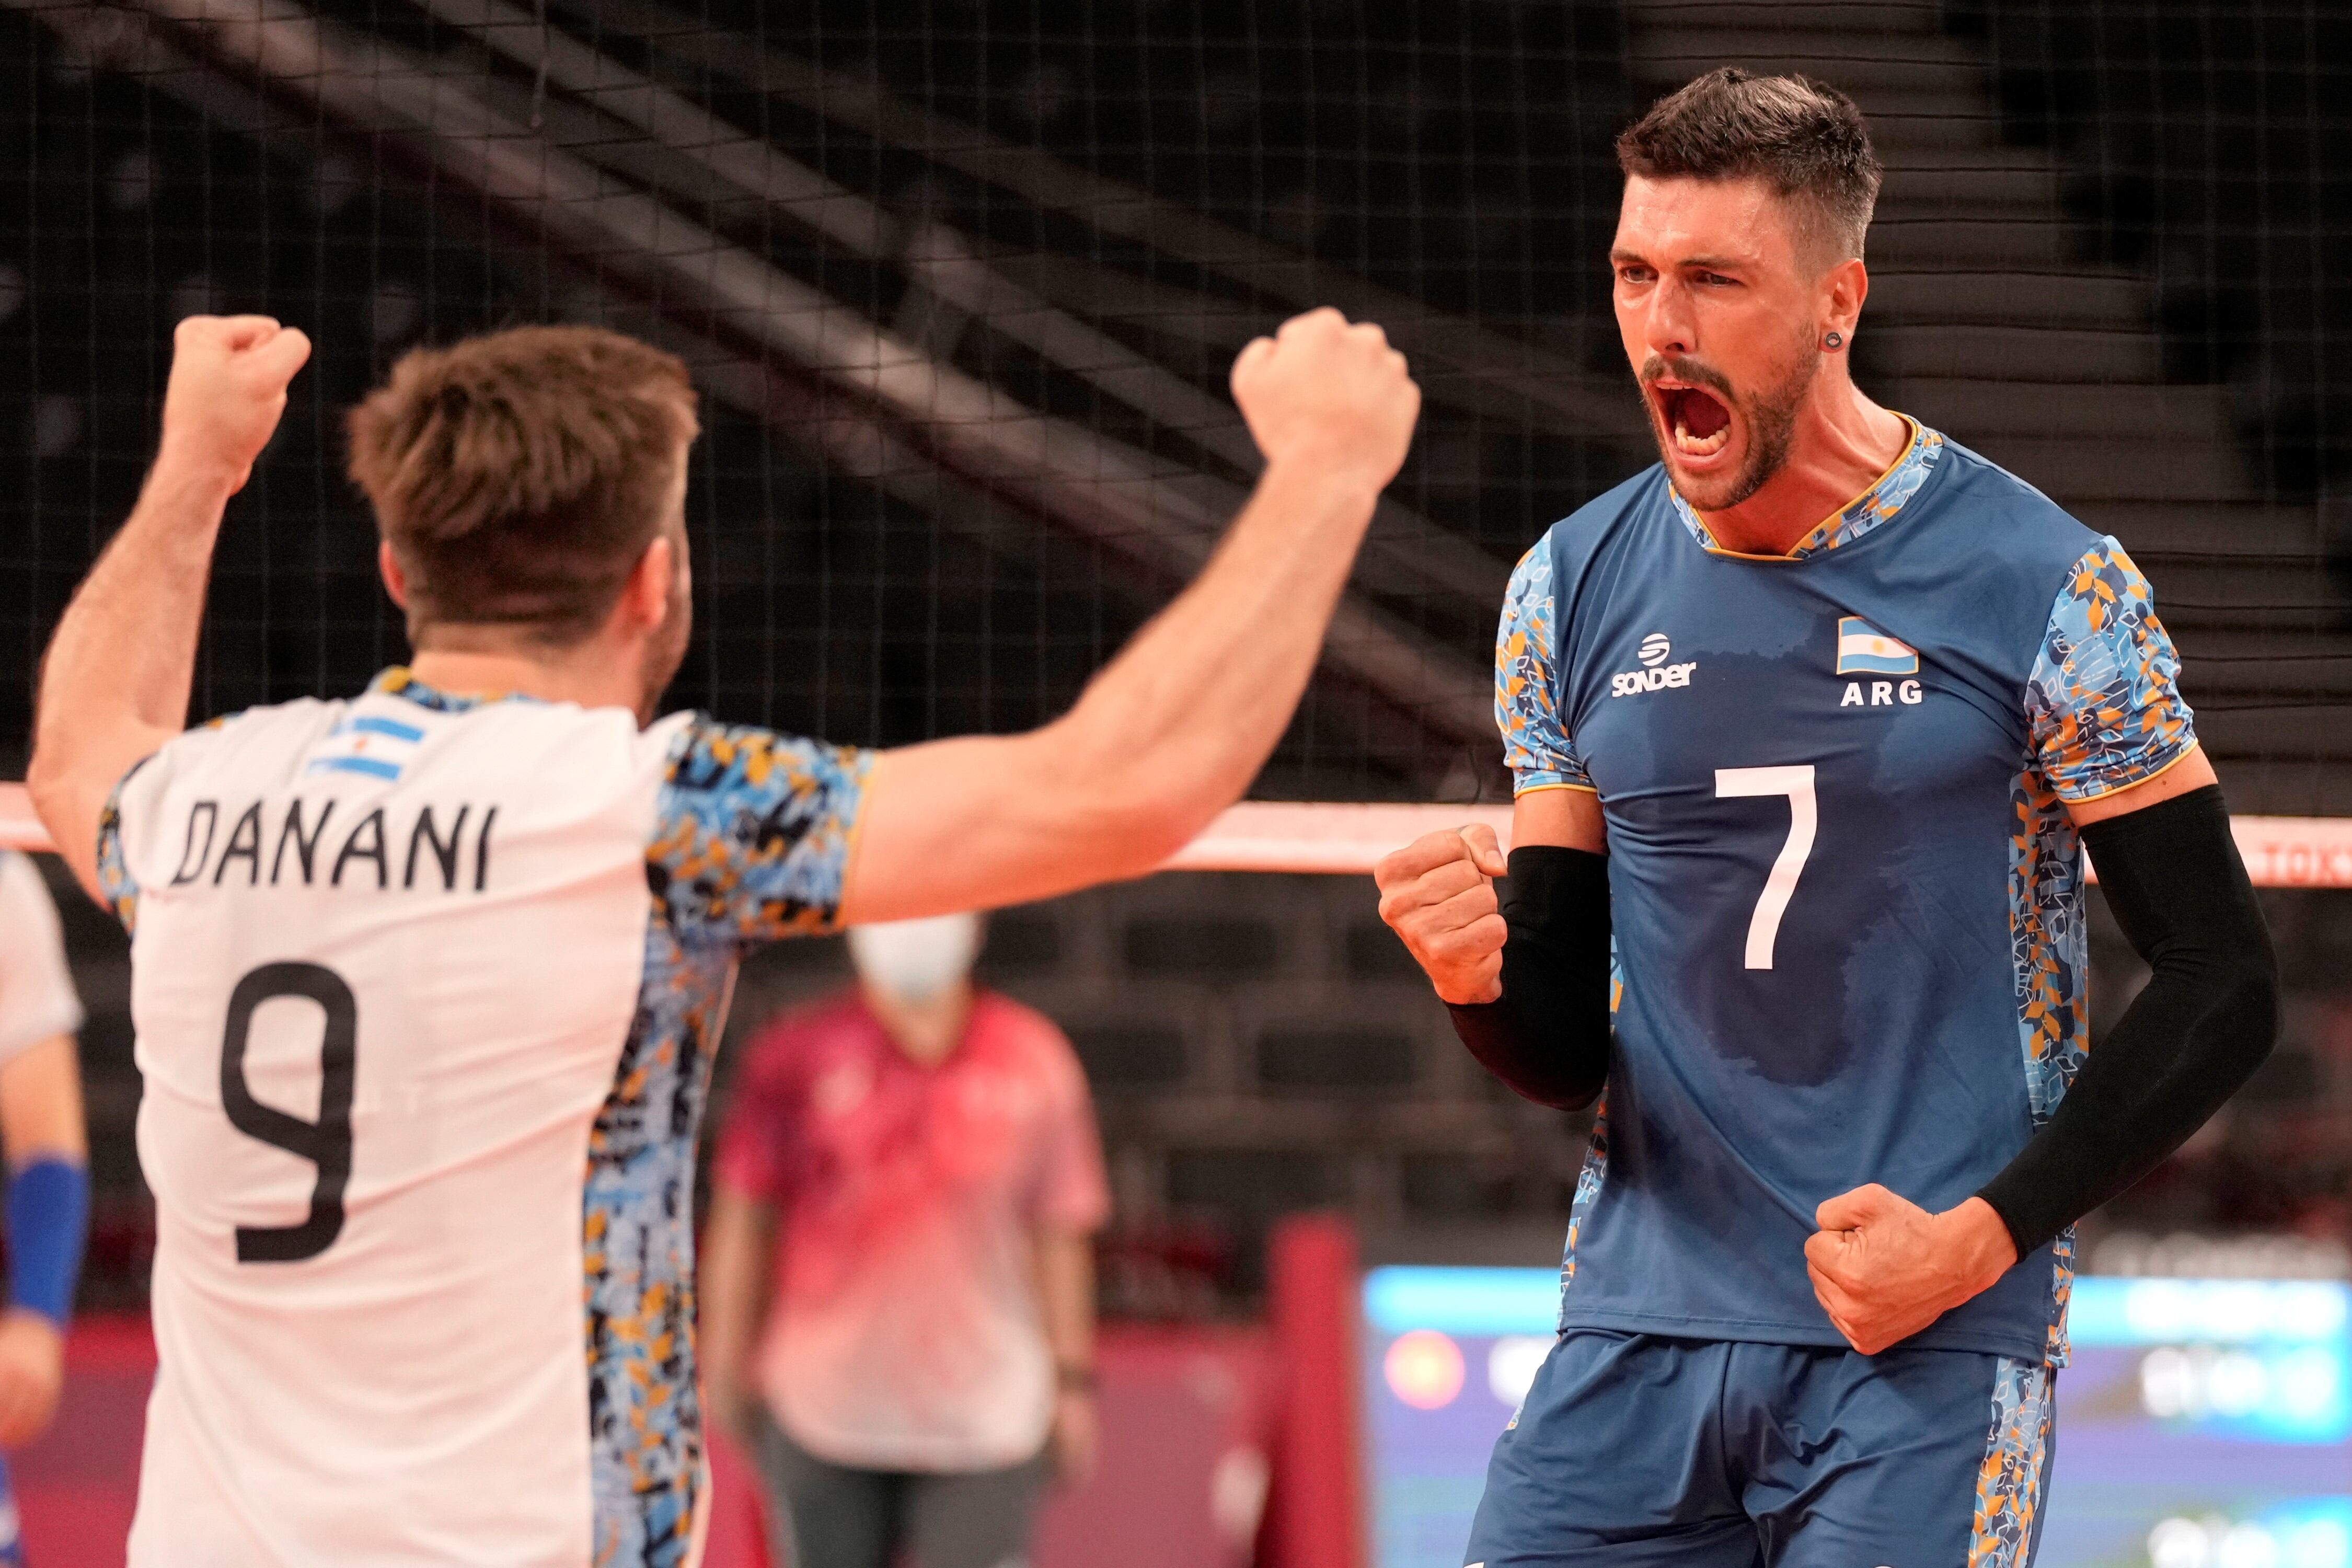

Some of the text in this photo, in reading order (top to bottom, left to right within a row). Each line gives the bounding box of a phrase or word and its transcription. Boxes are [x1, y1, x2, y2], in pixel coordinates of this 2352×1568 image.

[1840, 679, 1922, 706] ARG
[170, 798, 499, 892] DANANI
[1715, 765, 1817, 970] 7
[2263, 843, 2352, 885] TOK
[221, 962, 358, 1265] 9
